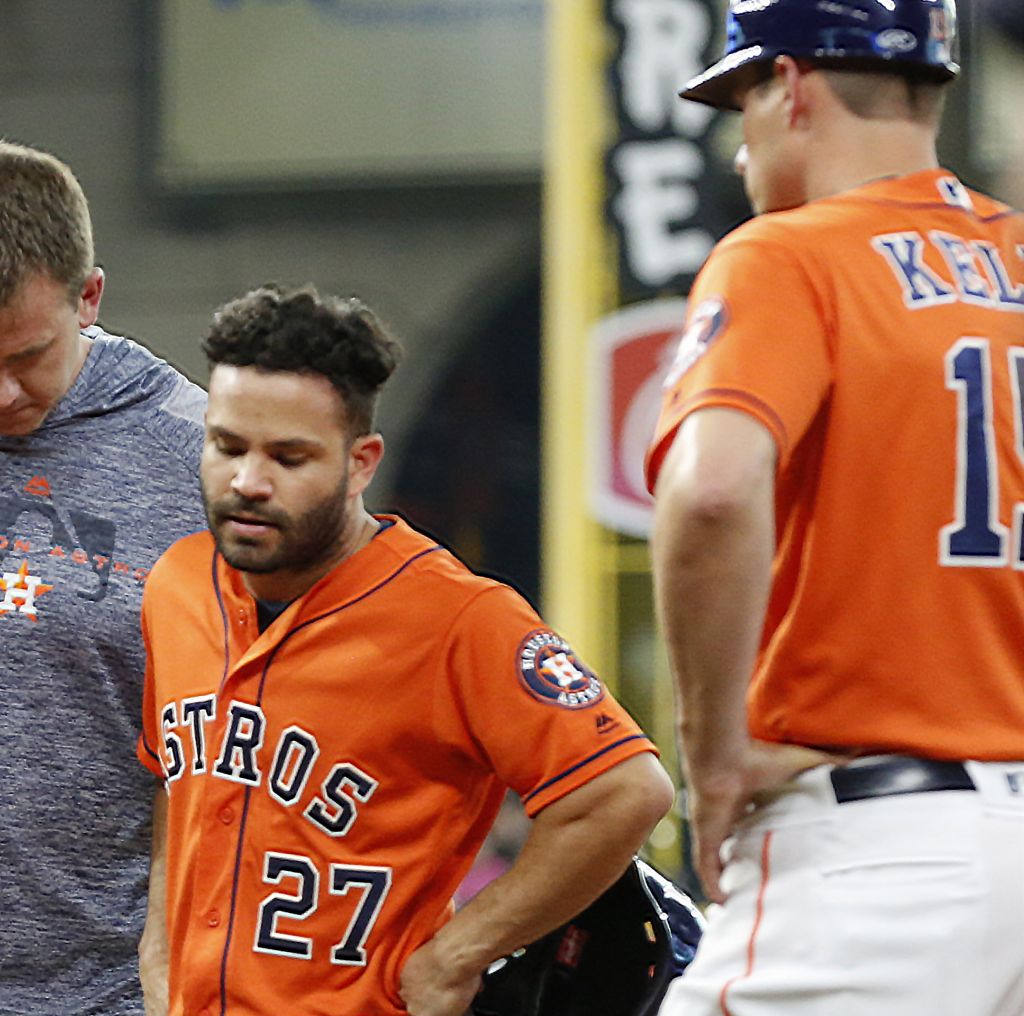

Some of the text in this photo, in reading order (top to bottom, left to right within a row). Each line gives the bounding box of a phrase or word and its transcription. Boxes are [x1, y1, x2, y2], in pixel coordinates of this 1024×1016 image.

[871, 229, 1024, 312] KEL
[938, 336, 1024, 570] 1
[253, 851, 392, 966] 27
